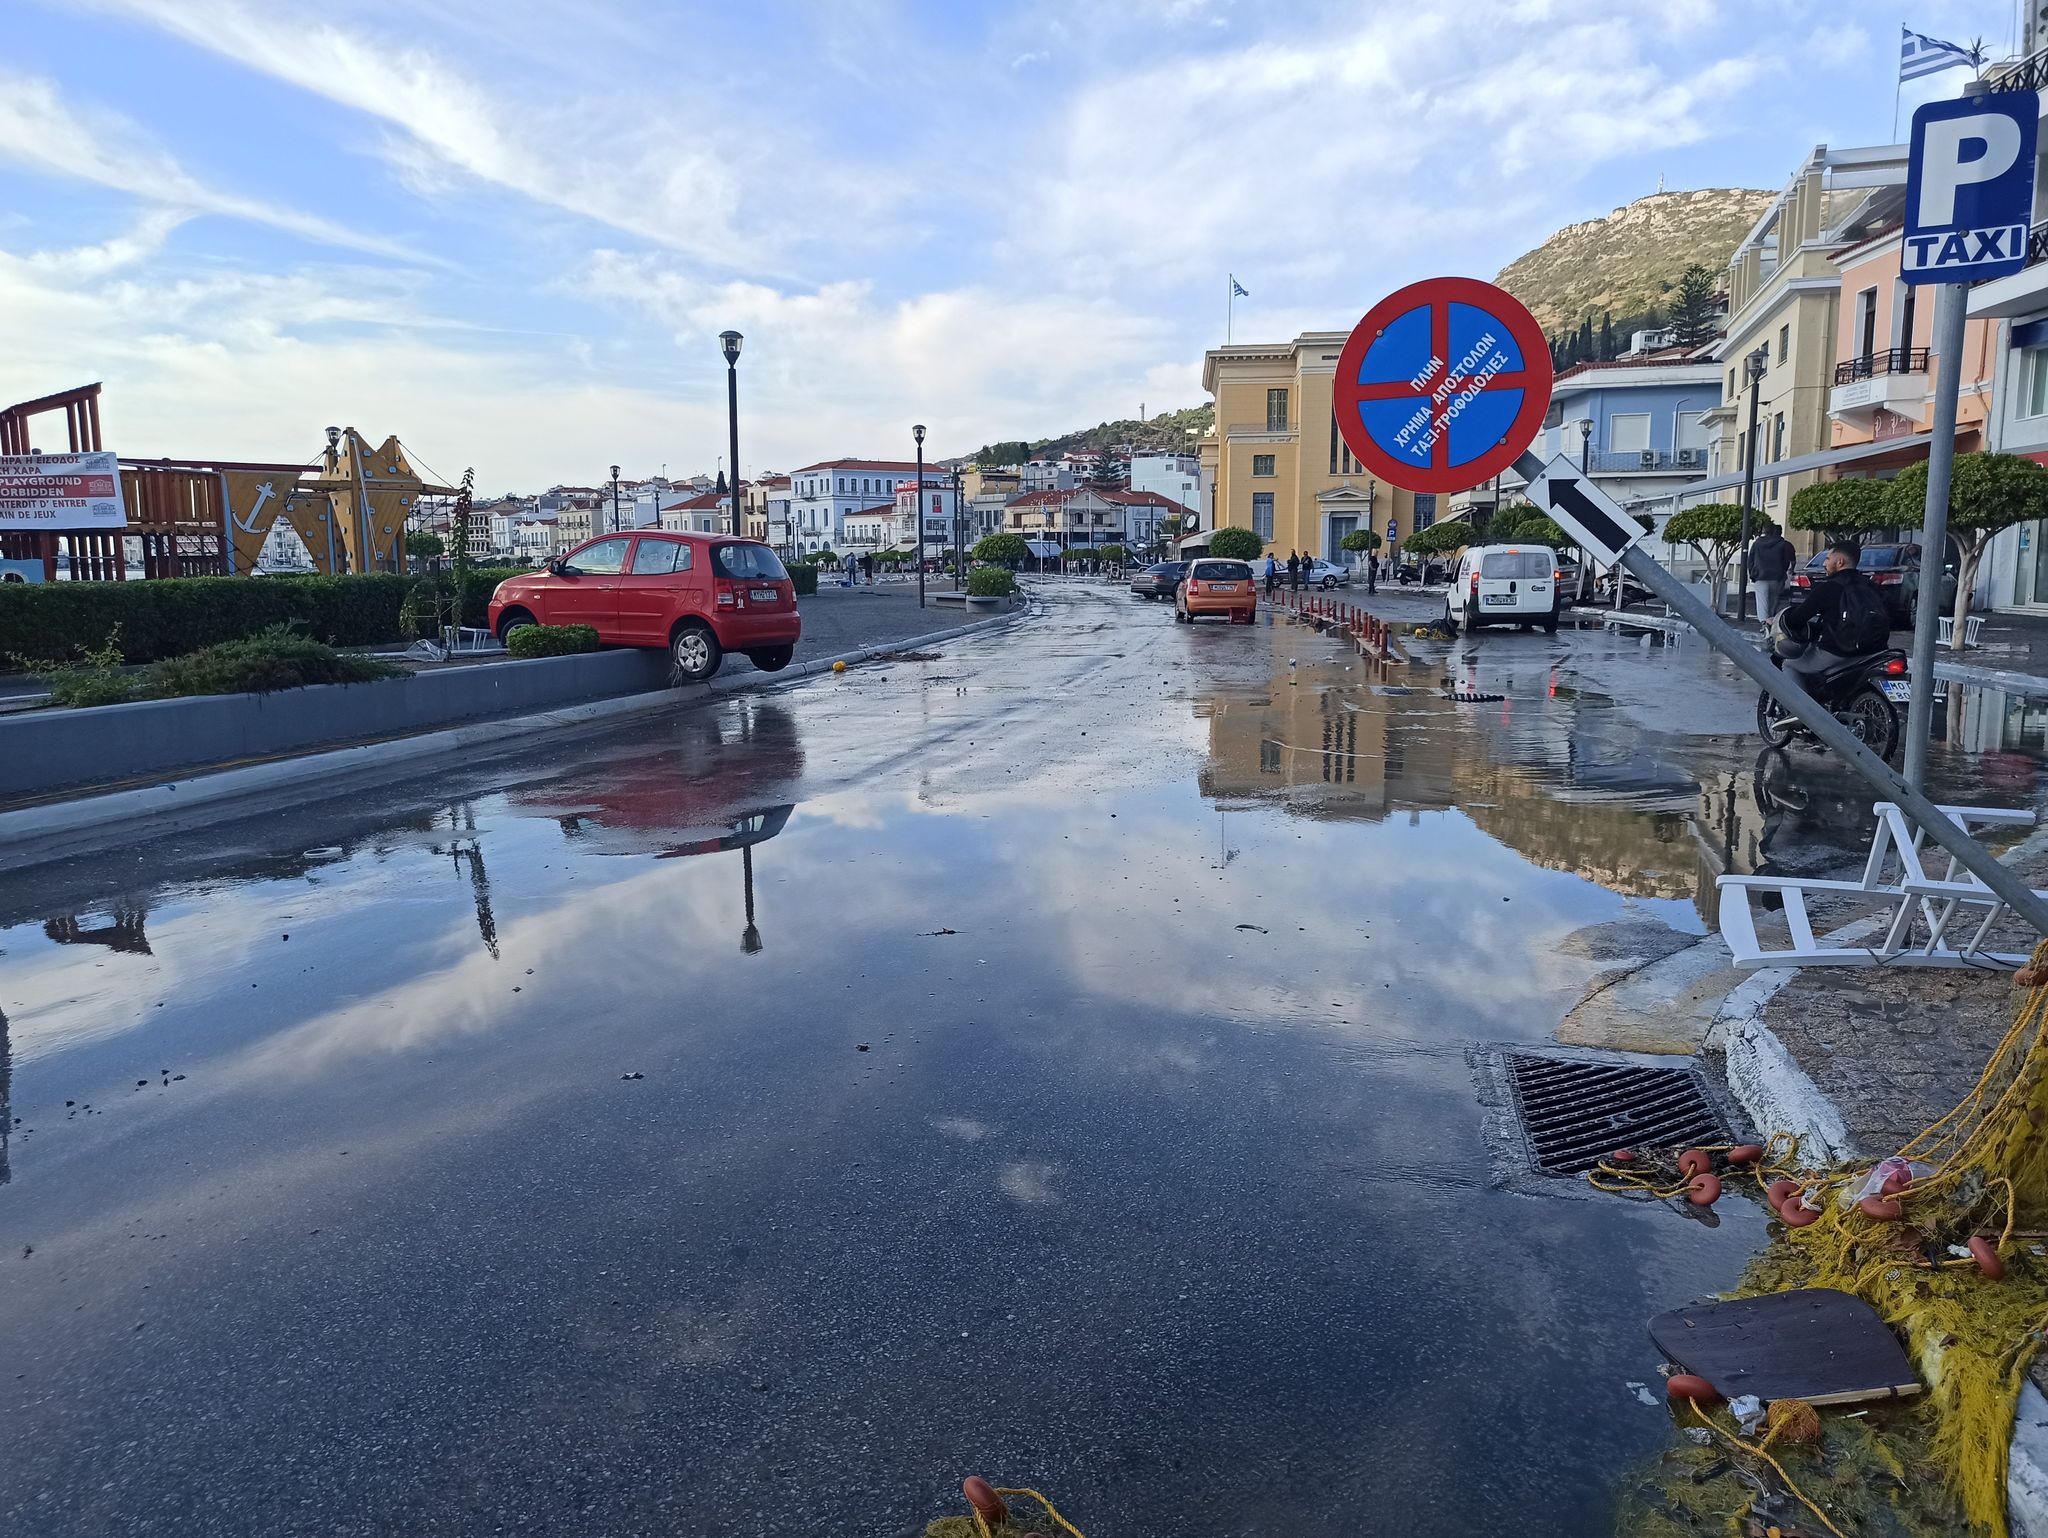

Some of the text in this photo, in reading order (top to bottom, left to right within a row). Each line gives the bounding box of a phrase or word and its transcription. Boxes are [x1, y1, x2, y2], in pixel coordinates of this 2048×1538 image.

[1918, 113, 2021, 228] P
[1908, 226, 2023, 268] TAXI
[1409, 355, 1445, 392] ΠΛΗΝ
[1393, 332, 1497, 448] ΧΡΗΜΑ ΑΠΟΣΤΟΛΩΝ
[1410, 350, 1509, 457] ΤΑΞΙ-ΤΡΟΦΟΔΟΣΙΕΣ
[14, 467, 42, 475] ΧΑΡΑ
[26, 456, 33, 464] Η
[36, 456, 81, 464] ΕΙΣΟΔΟΣ
[0, 477, 82, 486] PLAYGROUND
[18, 511, 33, 519] DE
[33, 510, 57, 519] JEUX
[53, 499, 88, 508] ENTRER
